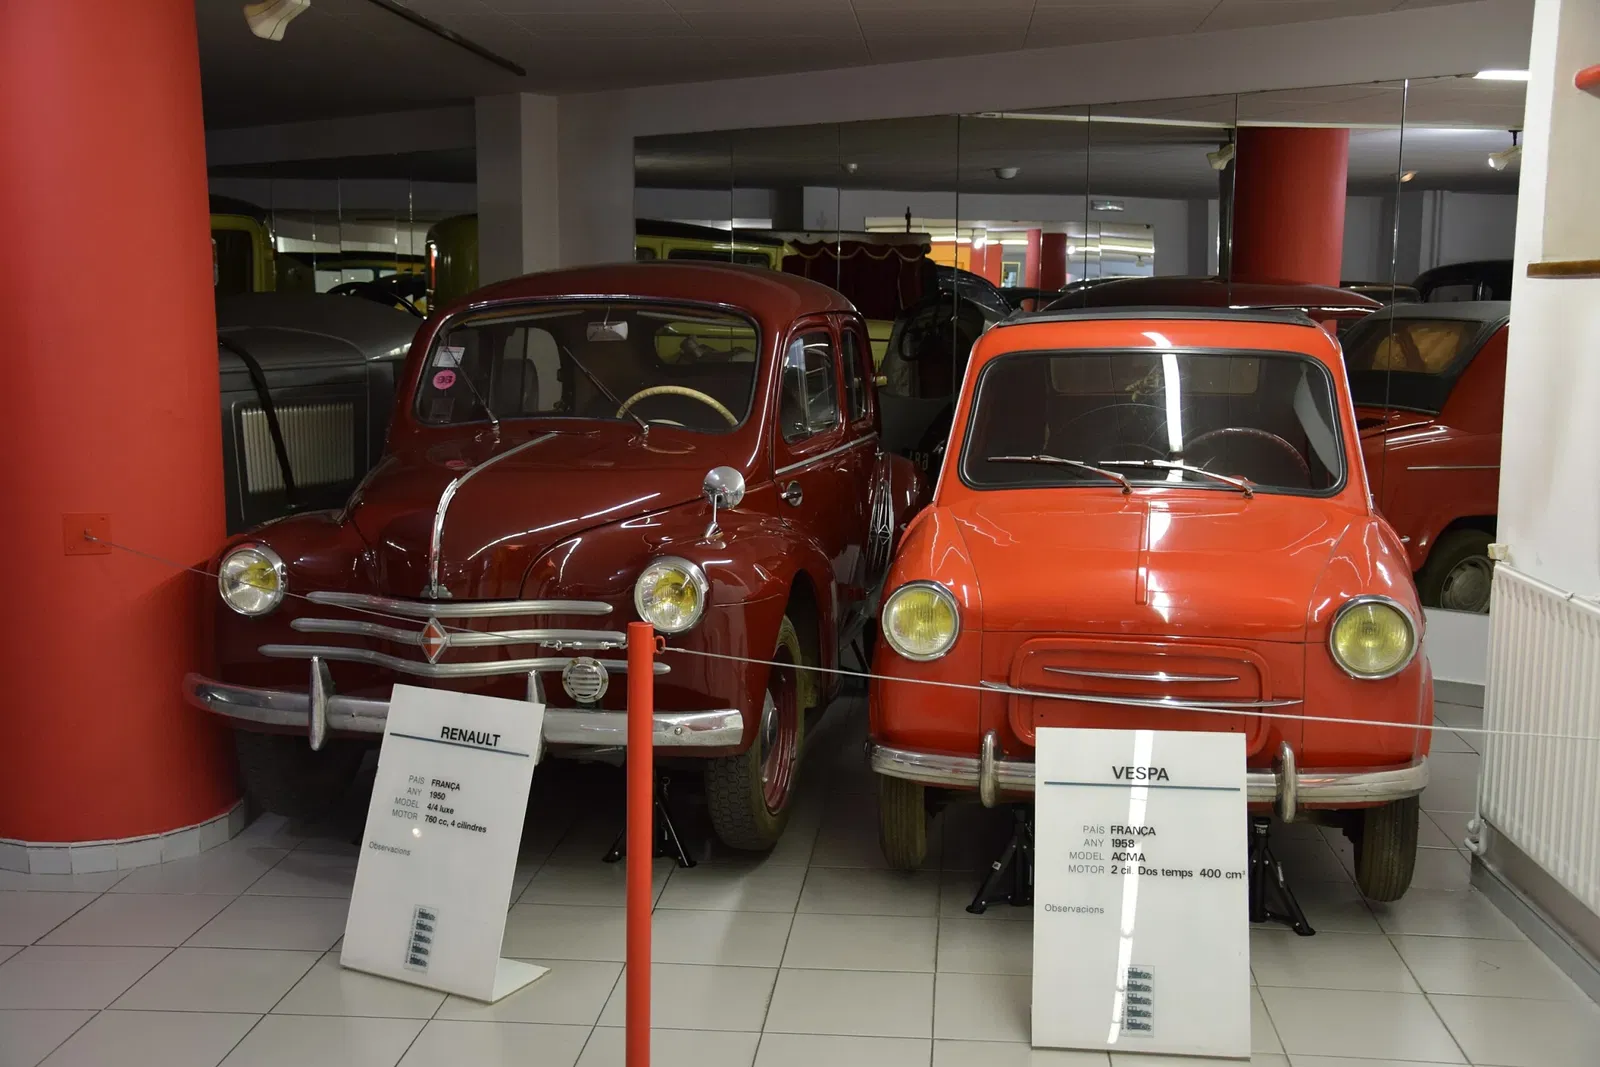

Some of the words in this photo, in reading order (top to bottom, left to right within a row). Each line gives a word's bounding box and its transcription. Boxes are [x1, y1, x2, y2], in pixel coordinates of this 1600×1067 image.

[440, 726, 501, 747] RENAULT
[1112, 766, 1170, 781] VESPA
[431, 779, 460, 791] FRANÇA
[407, 787, 422, 796] ANY
[430, 791, 446, 800] 1950
[394, 797, 420, 808] MODEL
[427, 803, 438, 812] 4/4
[440, 805, 454, 814] luxe
[392, 809, 418, 820] MOTOR
[424, 814, 438, 824] 760
[438, 818, 449, 827] cc,
[456, 820, 487, 833] cilindres
[1110, 825, 1156, 836] FRANÇA
[368, 841, 411, 856] Observacions
[1084, 838, 1104, 847] ANY
[1112, 838, 1135, 848] 1958
[1069, 852, 1104, 861] MODEL
[1112, 852, 1146, 862] ACMA
[1068, 865, 1104, 874] MOTOR
[1110, 865, 1118, 874] 2
[1120, 866, 1134, 875] cil.
[1138, 866, 1158, 876] Dos
[1161, 868, 1193, 879] temps
[1200, 868, 1222, 878] 400
[1044, 904, 1104, 914] Observacions
